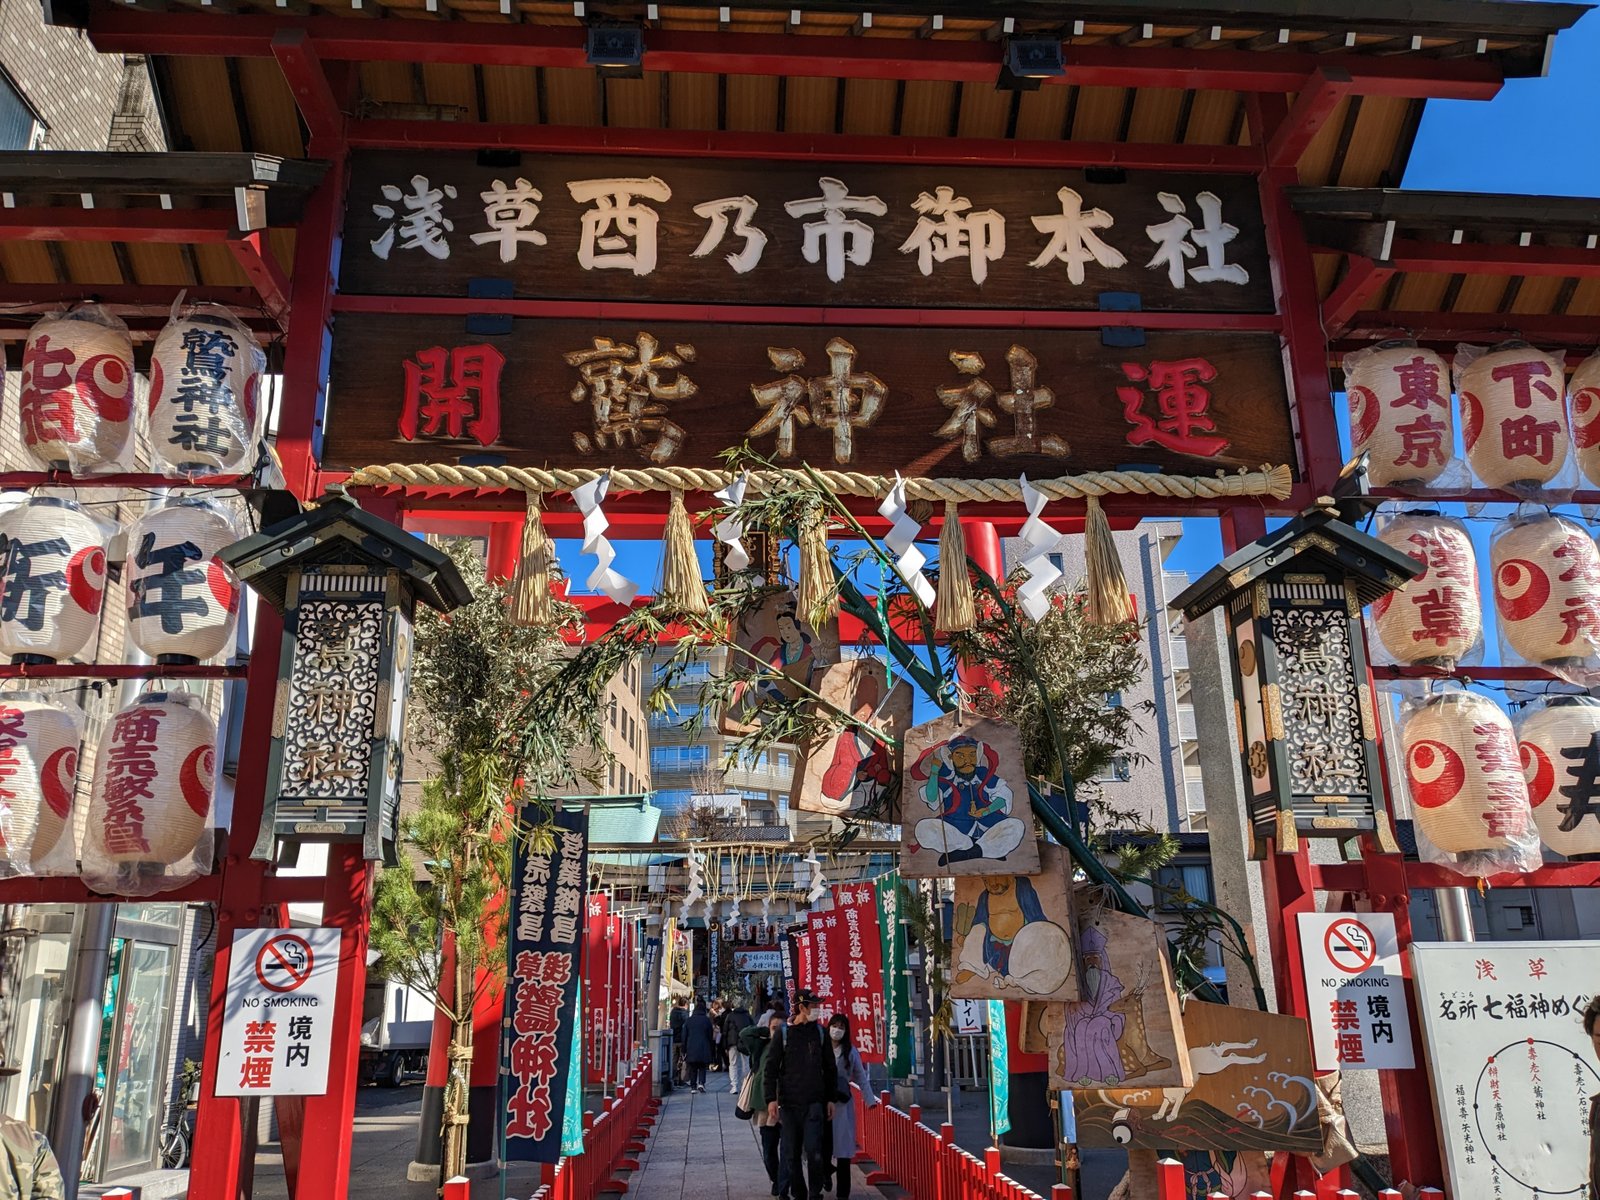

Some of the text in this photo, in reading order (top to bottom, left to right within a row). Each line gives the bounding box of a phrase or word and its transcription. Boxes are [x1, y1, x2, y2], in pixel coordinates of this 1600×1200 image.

[370, 173, 1250, 290] 浅草酉乃市御本社
[168, 328, 239, 457] 鷲神社
[397, 330, 1231, 464] 開 鷲神社 運
[1389, 356, 1448, 468] 東京
[1491, 360, 1562, 466] 下町
[127, 531, 210, 635] 年
[102, 706, 167, 855] 商売繁昌
[242, 997, 319, 1008] NO SMOKING
[1321, 977, 1390, 988] NO SMOKING
[1475, 957, 1548, 981] 浅草
[238, 1020, 278, 1089] 禁煙
[285, 1015, 314, 1068] 境内
[1329, 999, 1366, 1064] 禁煙
[1366, 994, 1394, 1045] 境内
